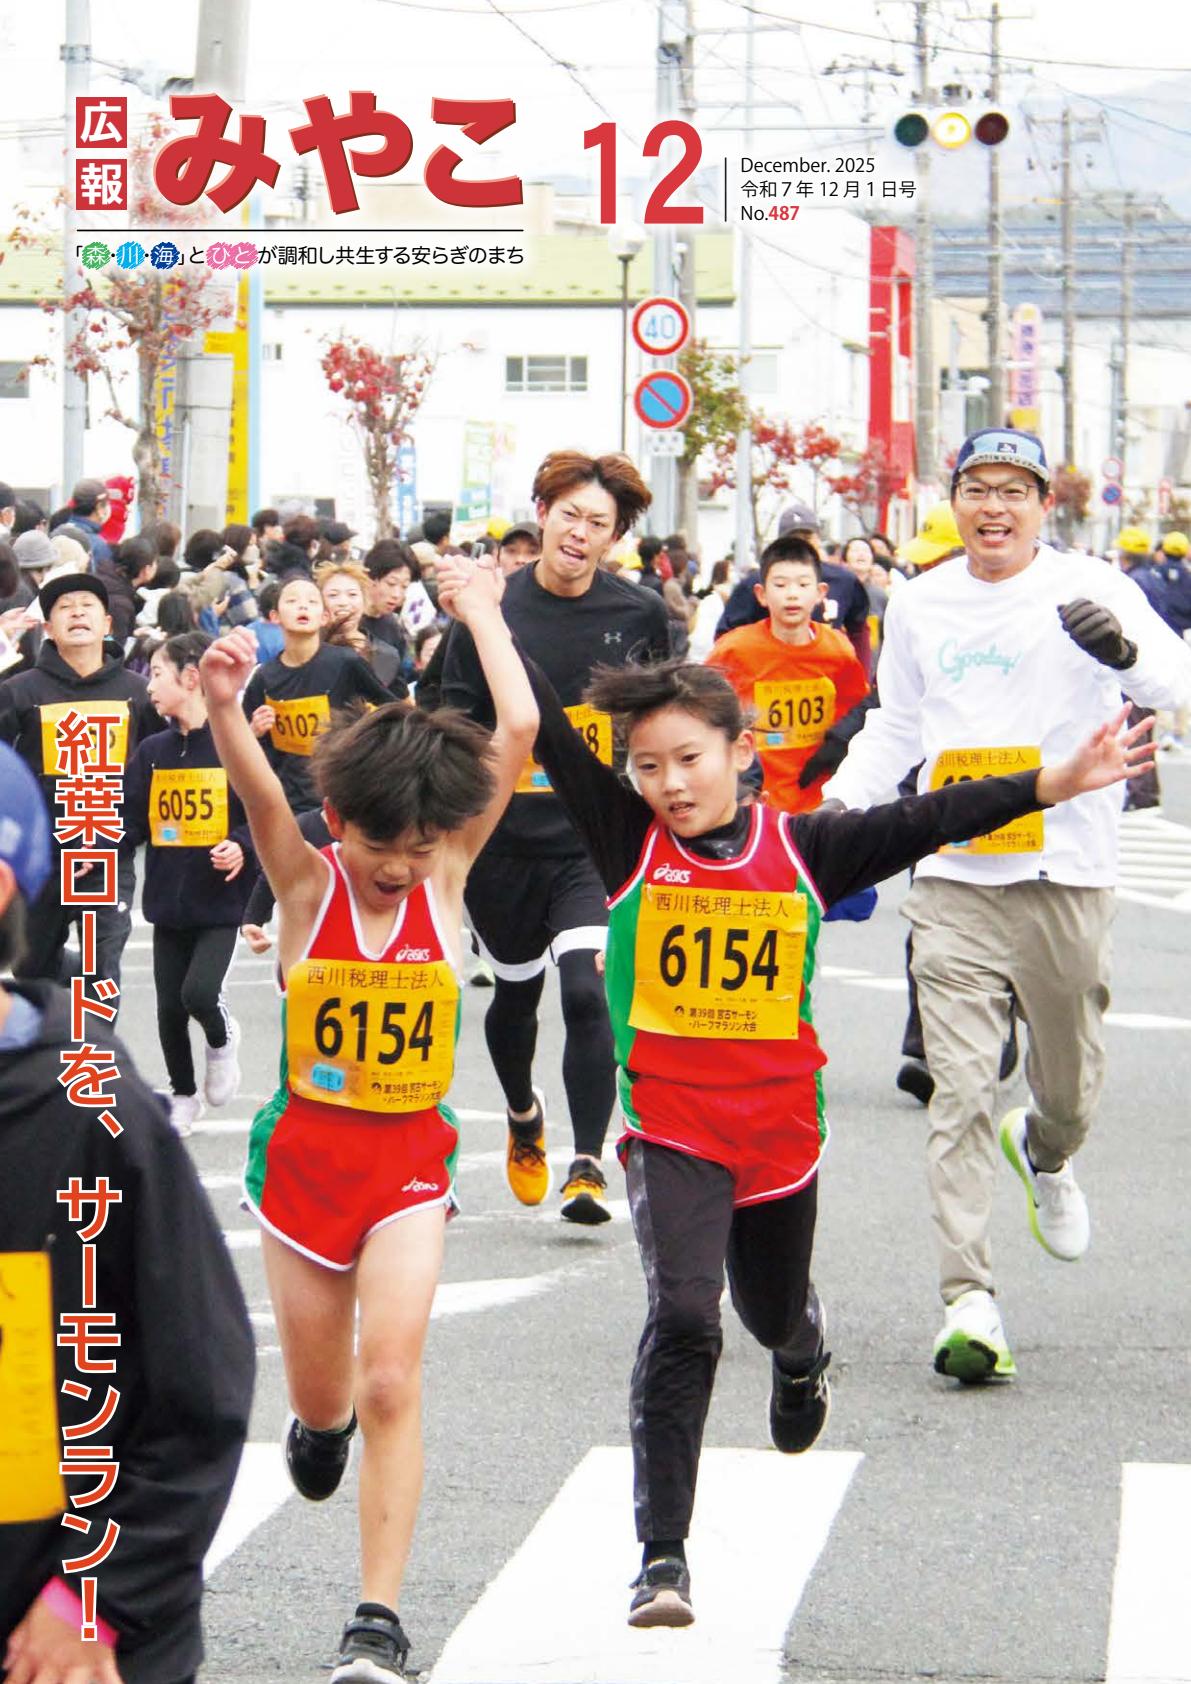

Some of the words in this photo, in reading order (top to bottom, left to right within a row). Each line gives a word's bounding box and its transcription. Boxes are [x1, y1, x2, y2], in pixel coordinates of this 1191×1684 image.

[645, 314, 676, 339] 40
[275, 713, 321, 738] 6102
[768, 695, 825, 729] 6103
[158, 789, 213, 821] 6055
[656, 892, 789, 918] 西川税理士法人
[660, 924, 779, 991] 6154
[307, 965, 445, 991] 西川税理士法人
[315, 997, 434, 1065] 6154
